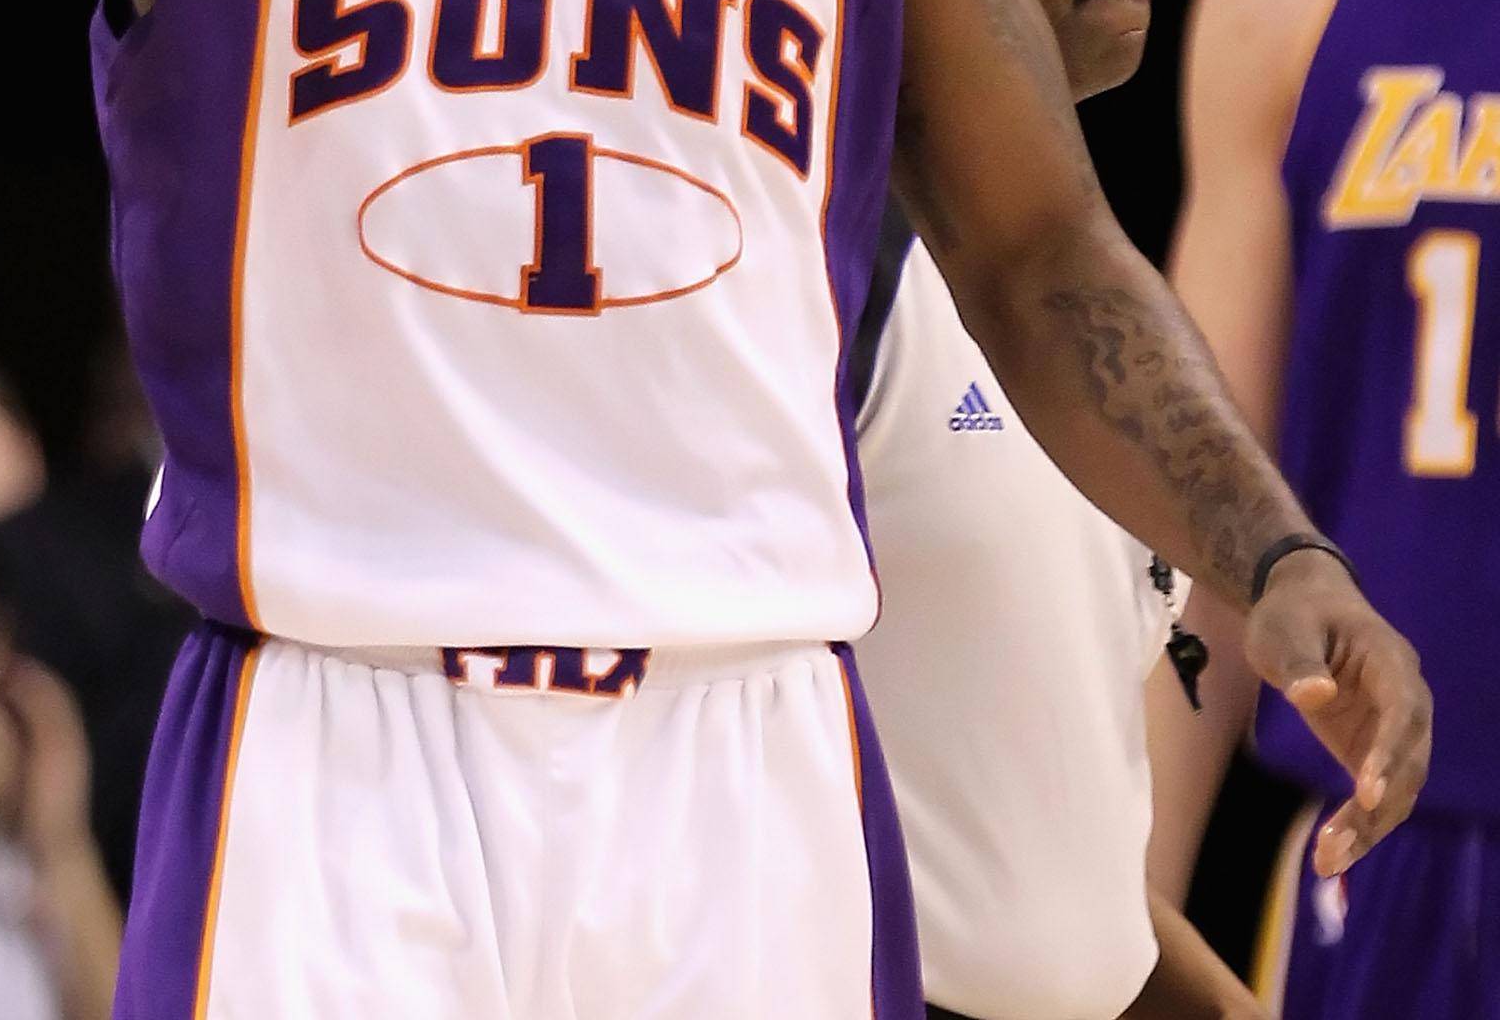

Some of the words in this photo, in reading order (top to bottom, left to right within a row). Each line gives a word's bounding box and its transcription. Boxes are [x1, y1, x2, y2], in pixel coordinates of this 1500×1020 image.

[521, 130, 603, 316] 1
[947, 415, 1004, 432] adidas
[1402, 228, 1500, 478] 1
